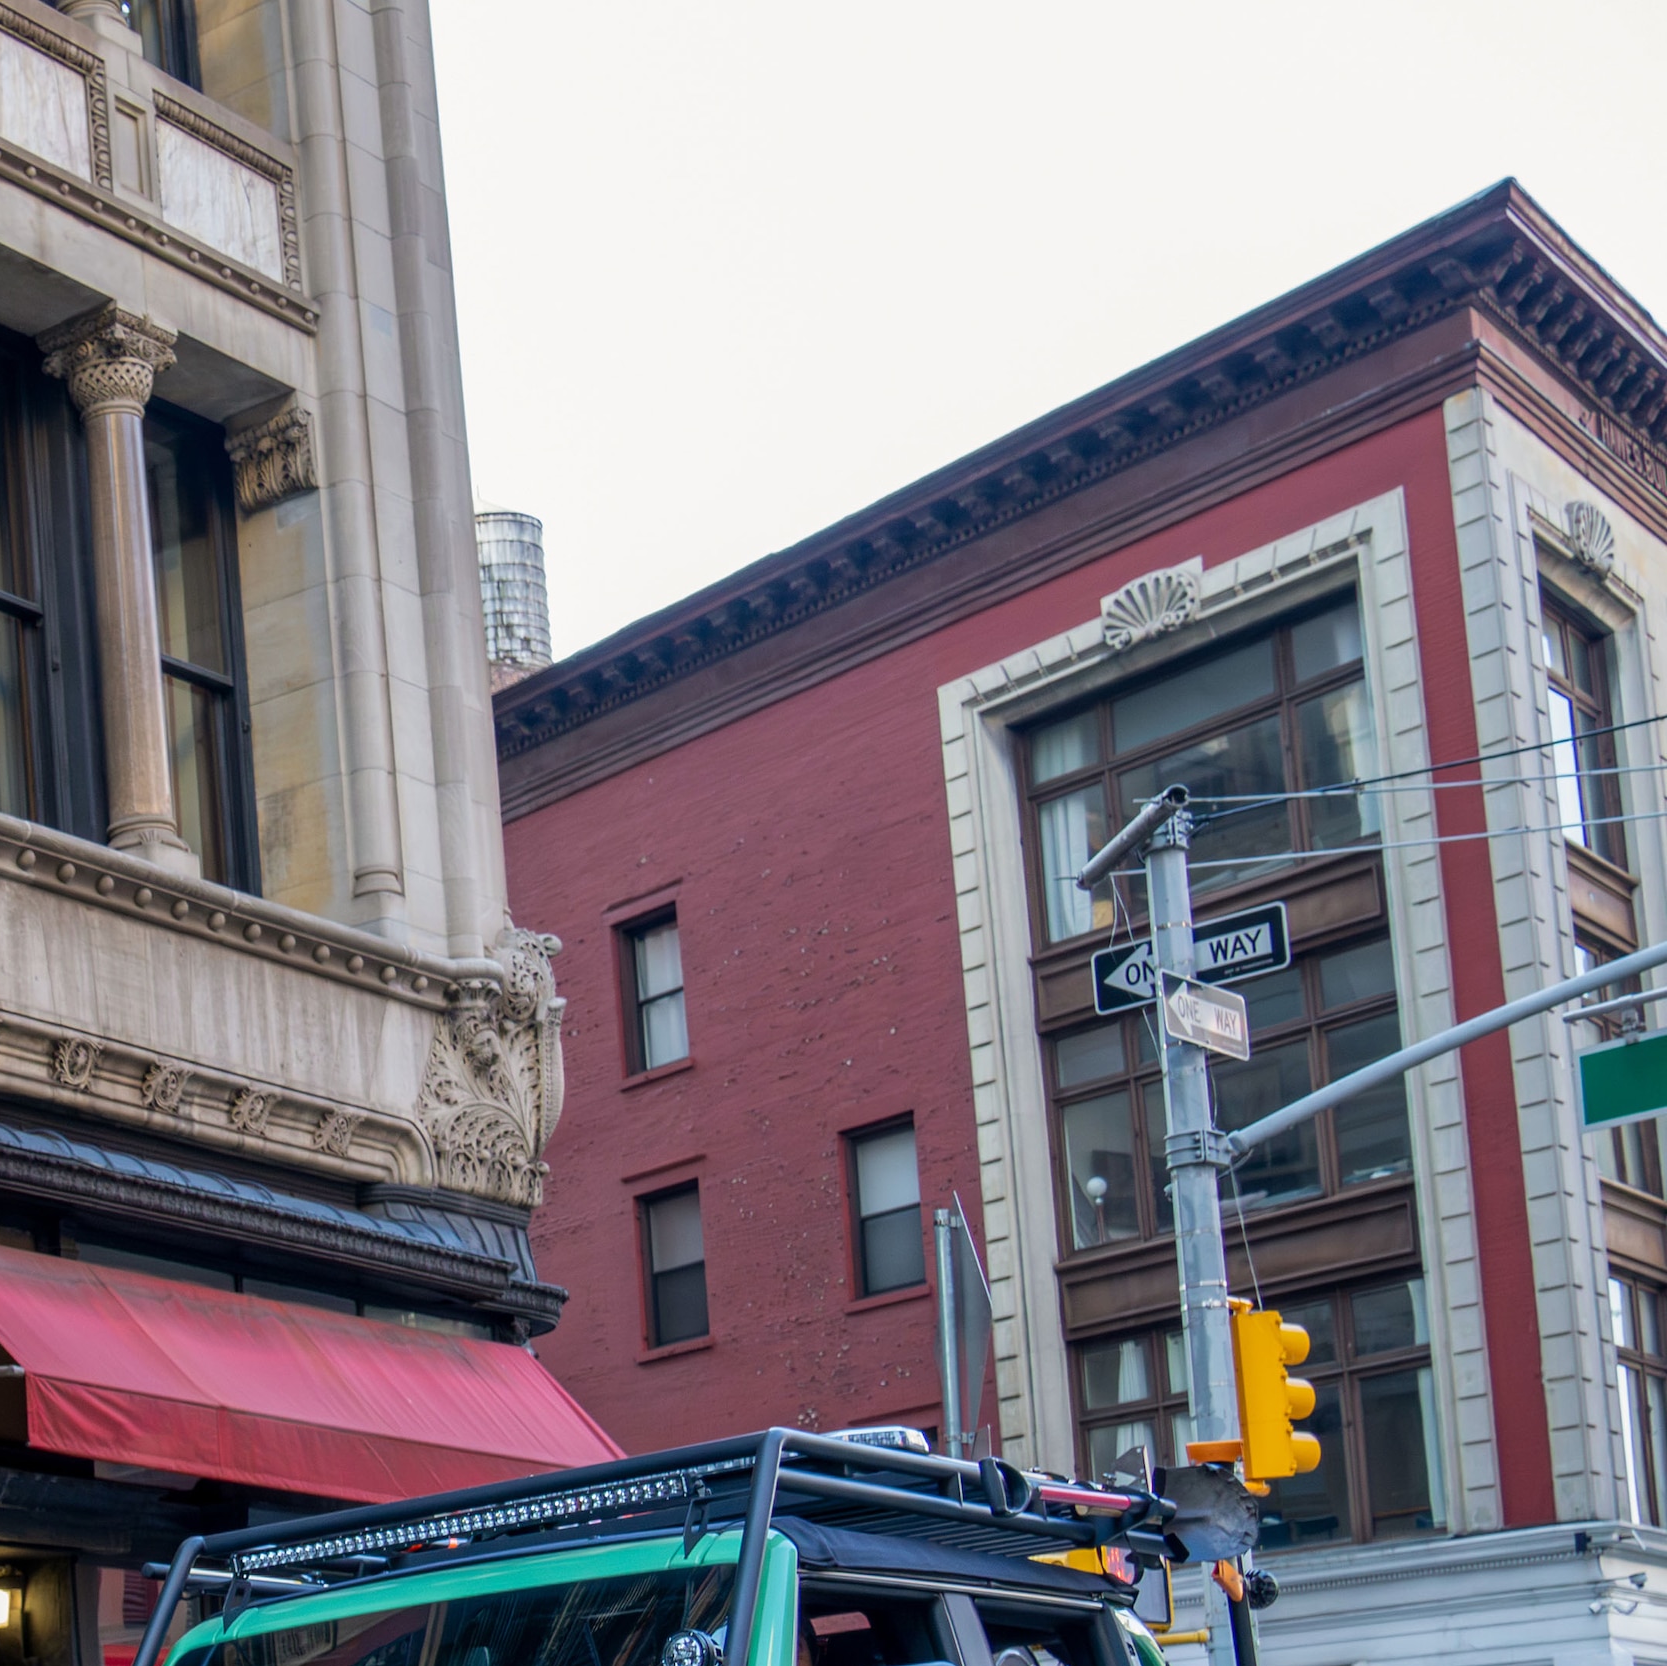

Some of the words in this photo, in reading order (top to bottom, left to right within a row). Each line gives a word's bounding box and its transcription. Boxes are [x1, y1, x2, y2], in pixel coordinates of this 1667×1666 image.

[1209, 928, 1262, 963] WAY
[1177, 995, 1202, 1023] ONE
[1214, 1007, 1237, 1034] WAY
